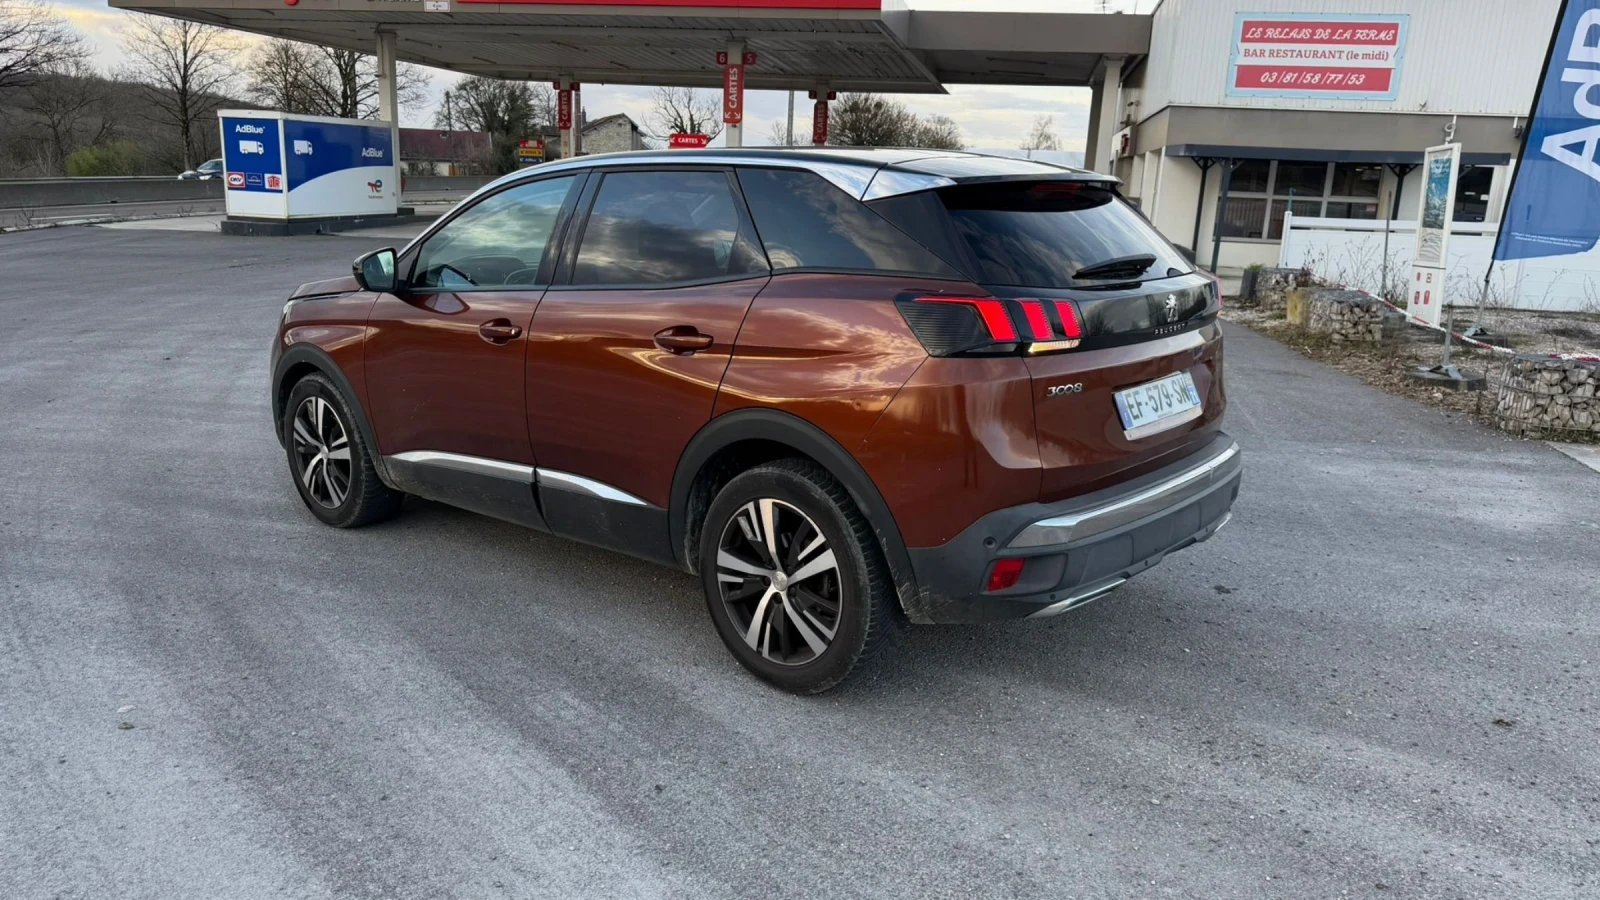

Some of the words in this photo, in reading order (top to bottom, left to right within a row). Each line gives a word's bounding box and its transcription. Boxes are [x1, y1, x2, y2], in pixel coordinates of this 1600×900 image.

[1245, 27, 1263, 39] LE
[1264, 28, 1312, 40] RELAIS
[1313, 28, 1329, 40] DE
[1332, 29, 1352, 41] LA
[1353, 29, 1395, 42] FERME
[719, 53, 726, 63] 6
[747, 53, 753, 63] 5
[1243, 48, 1266, 58] BAR
[1268, 49, 1345, 60] RESTAURANT
[1346, 50, 1359, 61] (le
[1361, 51, 1389, 62] midi)
[729, 67, 738, 109] CARTES
[1047, 382, 1083, 397] 3008
